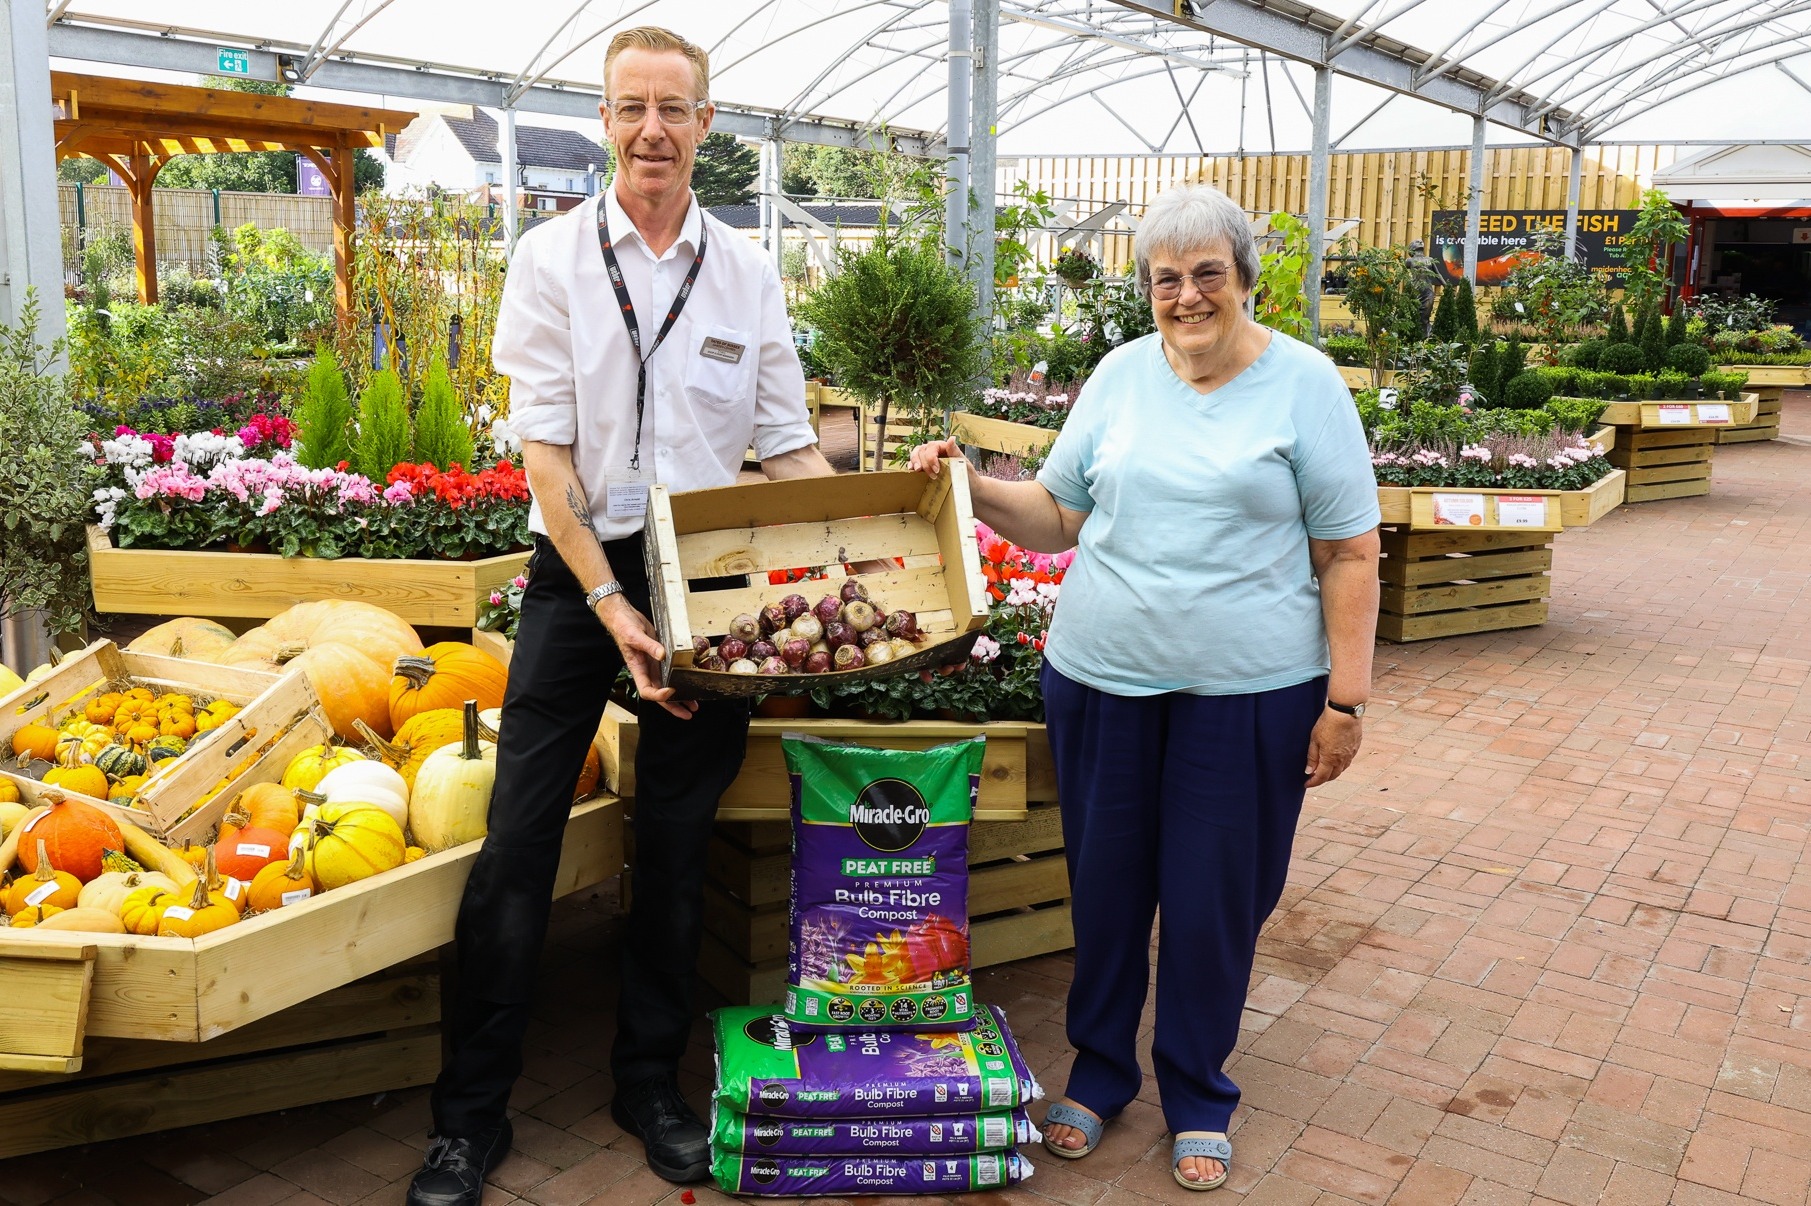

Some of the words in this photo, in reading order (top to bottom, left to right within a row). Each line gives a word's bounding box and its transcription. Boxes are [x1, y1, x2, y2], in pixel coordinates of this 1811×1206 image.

[219, 49, 233, 58] Fire
[234, 52, 247, 61] exit
[1522, 215, 1565, 232] THE
[1435, 235, 1445, 245] is
[1500, 235, 1527, 245] here
[1604, 236, 1616, 245] £1
[849, 804, 930, 824] Miracle-Gro
[846, 861, 887, 874] PEAT
[892, 861, 931, 874] FREE
[855, 879, 923, 888] PREMIUM
[834, 889, 883, 905] Bulb
[890, 889, 941, 907] Fibre
[858, 906, 918, 921] Compost
[798, 1092, 817, 1101] PEAT
[819, 1092, 837, 1101] FREE
[854, 1088, 883, 1100] Bulb
[886, 1087, 918, 1099] Fibre
[867, 1101, 904, 1109] Compost
[793, 1128, 813, 1137] PEAT
[814, 1128, 833, 1137] FREE
[850, 1125, 879, 1137] Bulb
[882, 1125, 914, 1137] Fibre
[862, 1138, 900, 1148] Compost
[788, 1168, 807, 1176] PEAT
[844, 1164, 873, 1176] Bulb
[876, 1164, 907, 1177] Fibre
[856, 1177, 894, 1185] Compost
